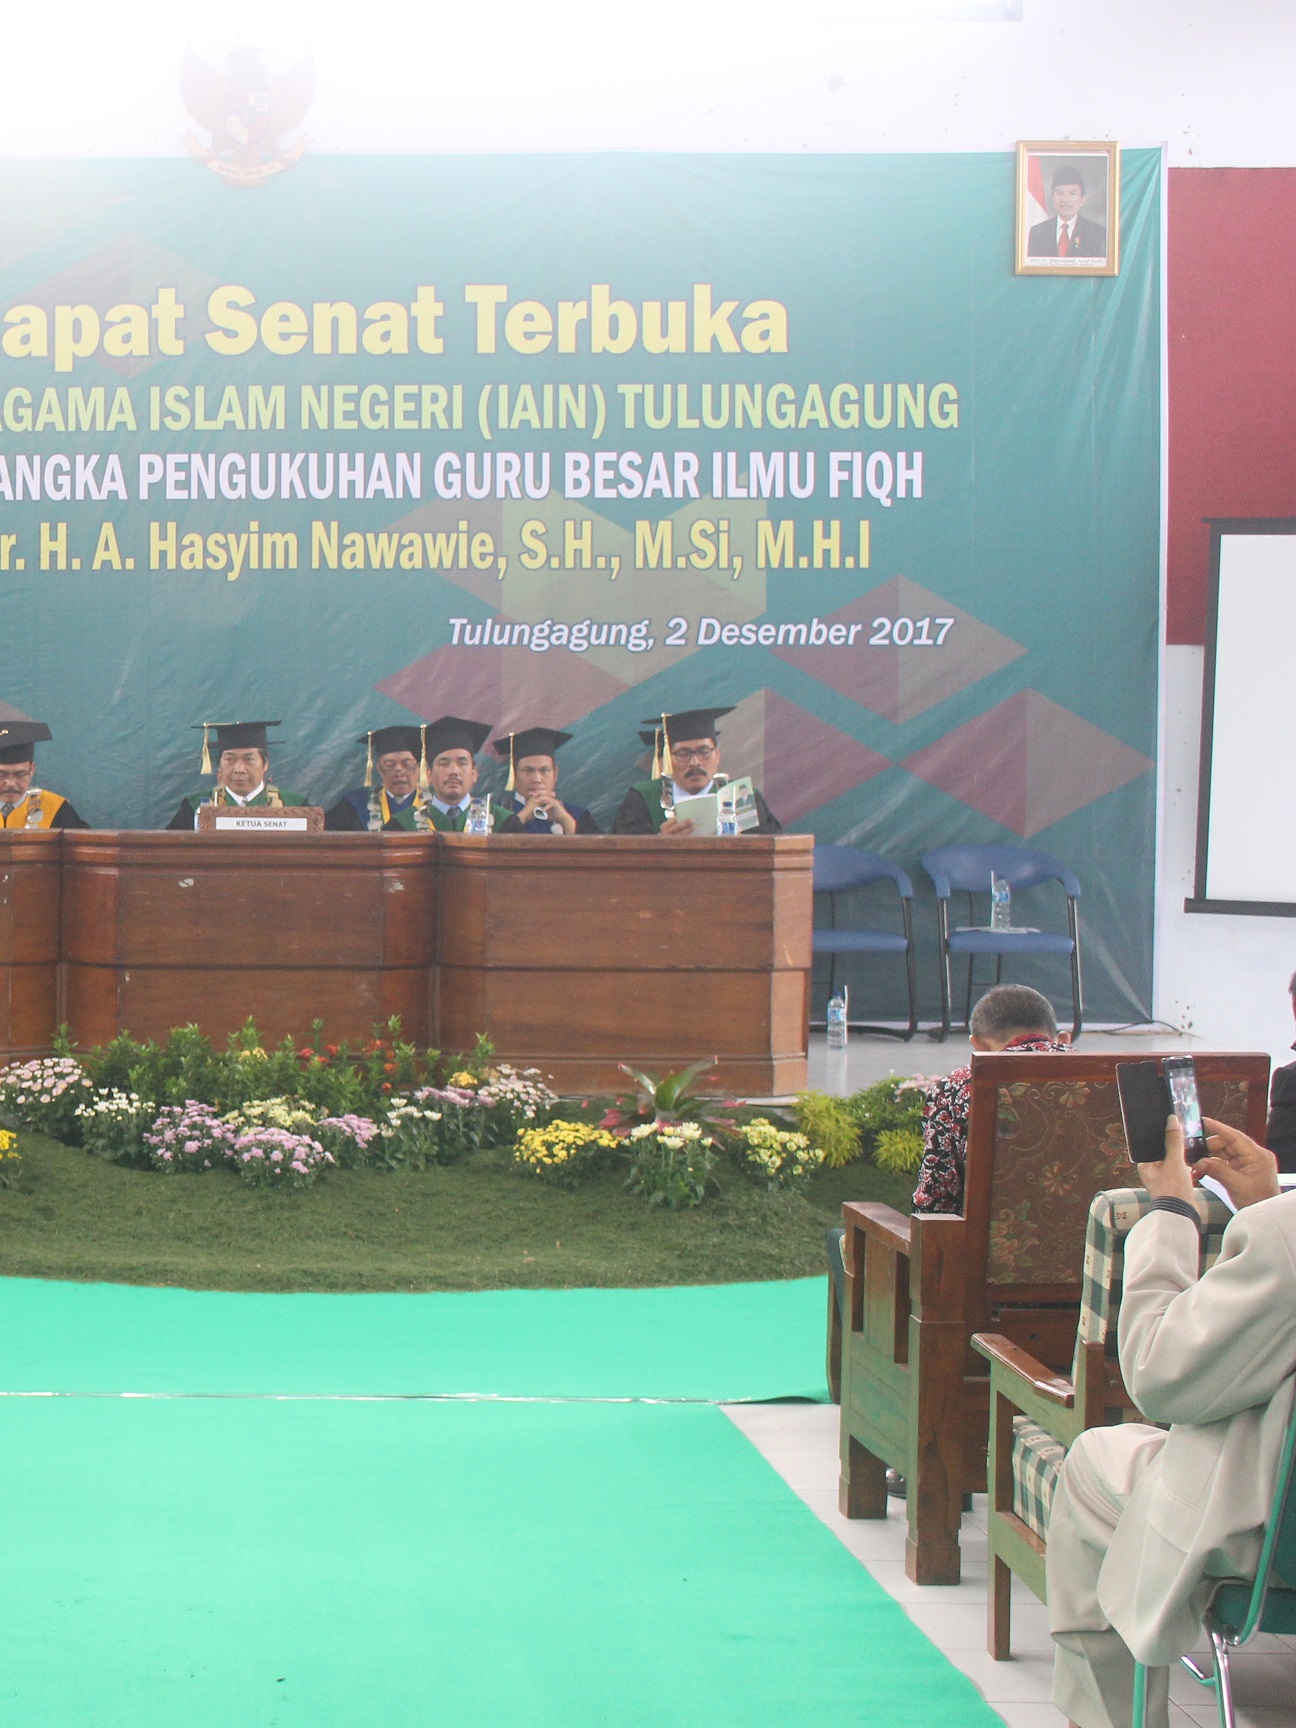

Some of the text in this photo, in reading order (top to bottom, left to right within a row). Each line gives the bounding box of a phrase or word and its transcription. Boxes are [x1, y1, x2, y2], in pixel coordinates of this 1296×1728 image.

[204, 284, 444, 355] Senat
[464, 283, 788, 354] Terbuka
[150, 384, 286, 431] ISLAM
[300, 383, 463, 430] NEGERI
[478, 383, 607, 440] (IAIN)
[617, 382, 960, 430] TULUNGAGUNG
[139, 452, 422, 500] PENGUKUHAN
[434, 451, 551, 499] GURU
[564, 450, 701, 499] BESAR
[712, 451, 815, 499] ILMU
[829, 450, 924, 507] FIQH
[39, 521, 81, 570] H.
[92, 521, 135, 570] A.
[149, 520, 298, 582] Hasyim
[311, 519, 507, 580] Nawawie,
[520, 519, 621, 580] S.H.,
[635, 519, 742, 580] M.Si,
[756, 519, 871, 569] M.H.I
[448, 615, 954, 652] Tulungagung, 2 Desember 2017
[235, 820, 262, 828] KETUA
